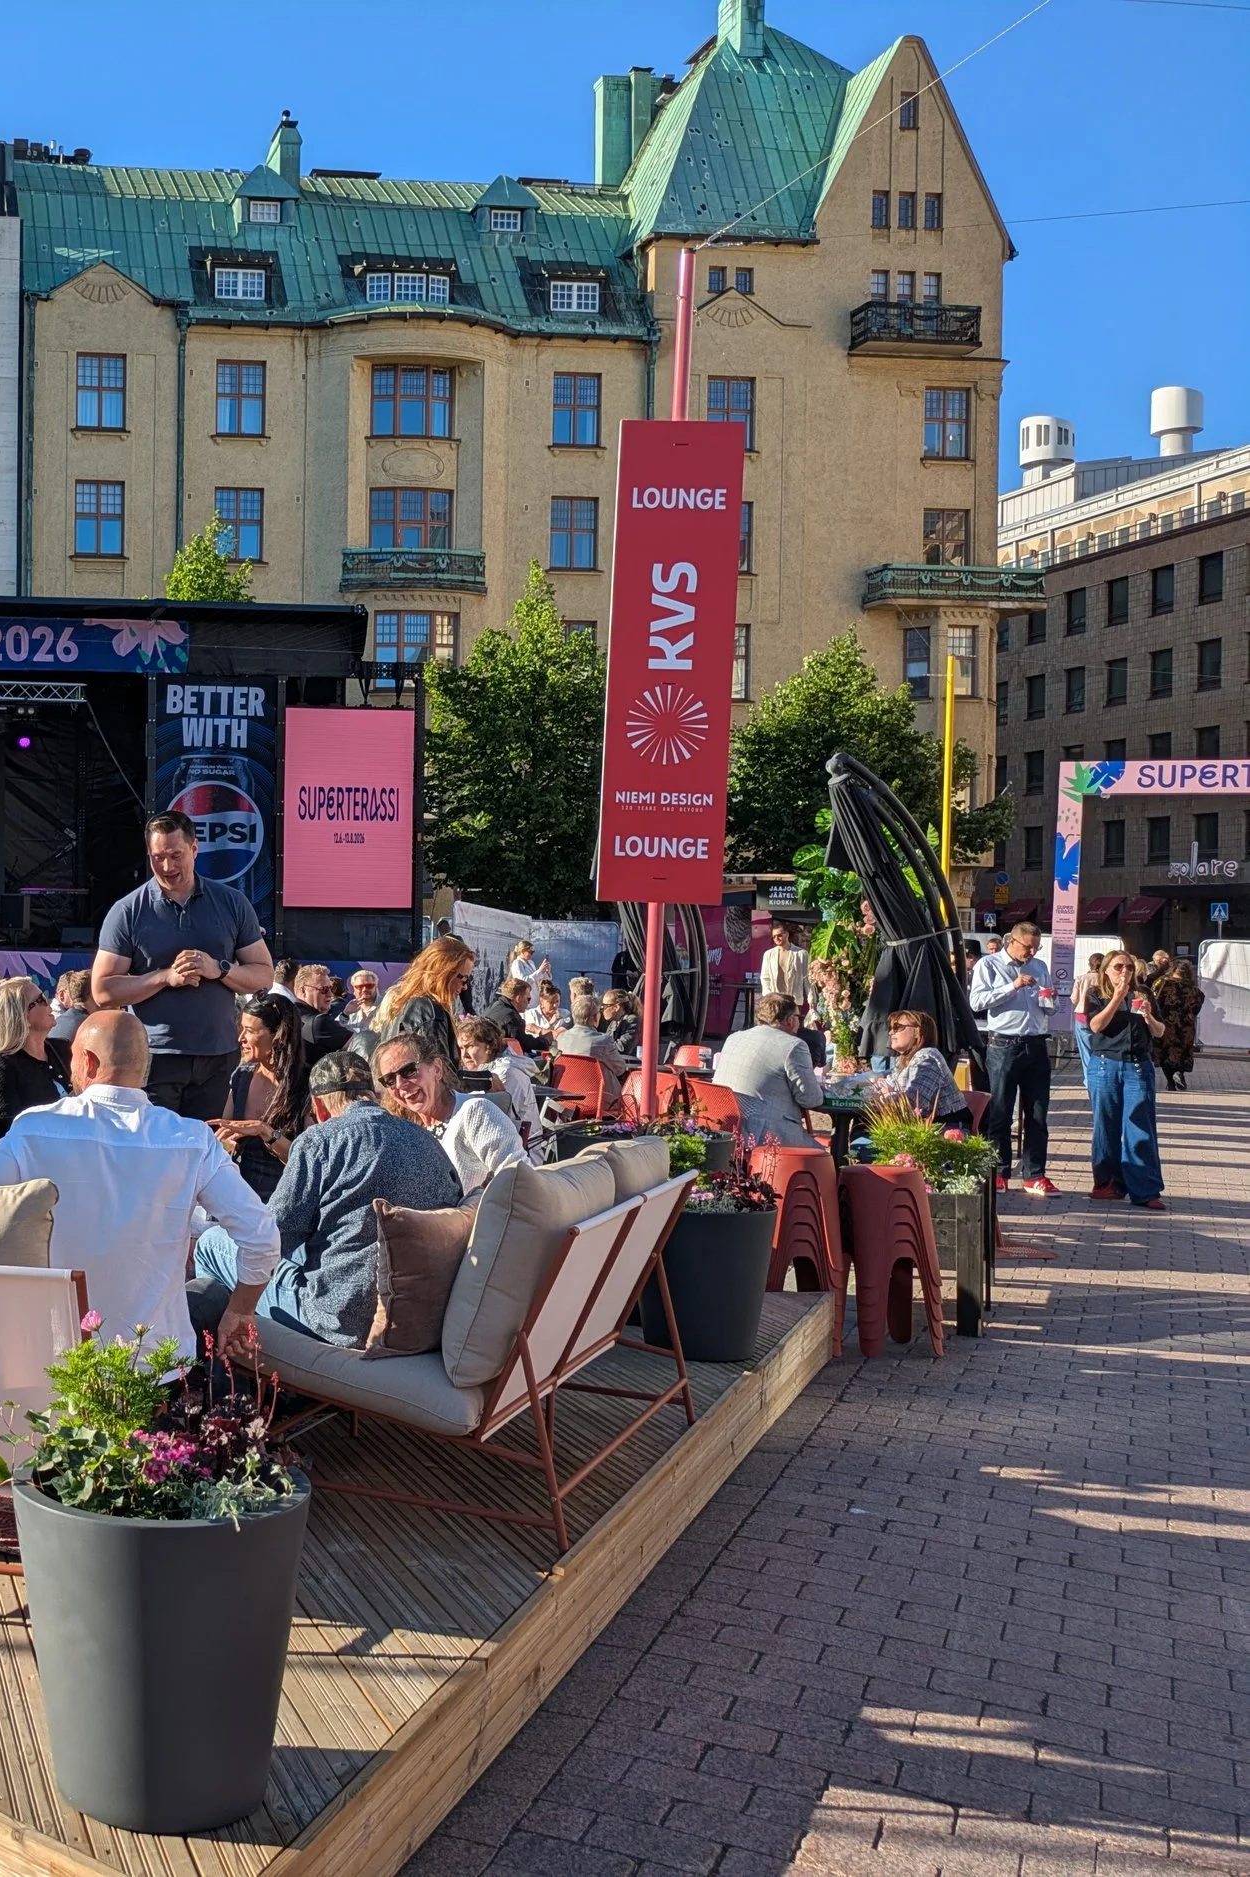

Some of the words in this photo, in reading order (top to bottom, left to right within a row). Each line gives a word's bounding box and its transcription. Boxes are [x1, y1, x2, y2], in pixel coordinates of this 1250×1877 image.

[632, 487, 726, 510] LOUNGE
[648, 561, 698, 670] KVS
[166, 684, 265, 717] BETTER
[181, 717, 248, 748] WITH
[298, 785, 399, 822] SUPERTERASSI
[615, 791, 655, 804] NIEMI
[661, 792, 713, 806] DESIGN
[194, 821, 257, 844] EPSI
[614, 835, 709, 859] LOUNGE
